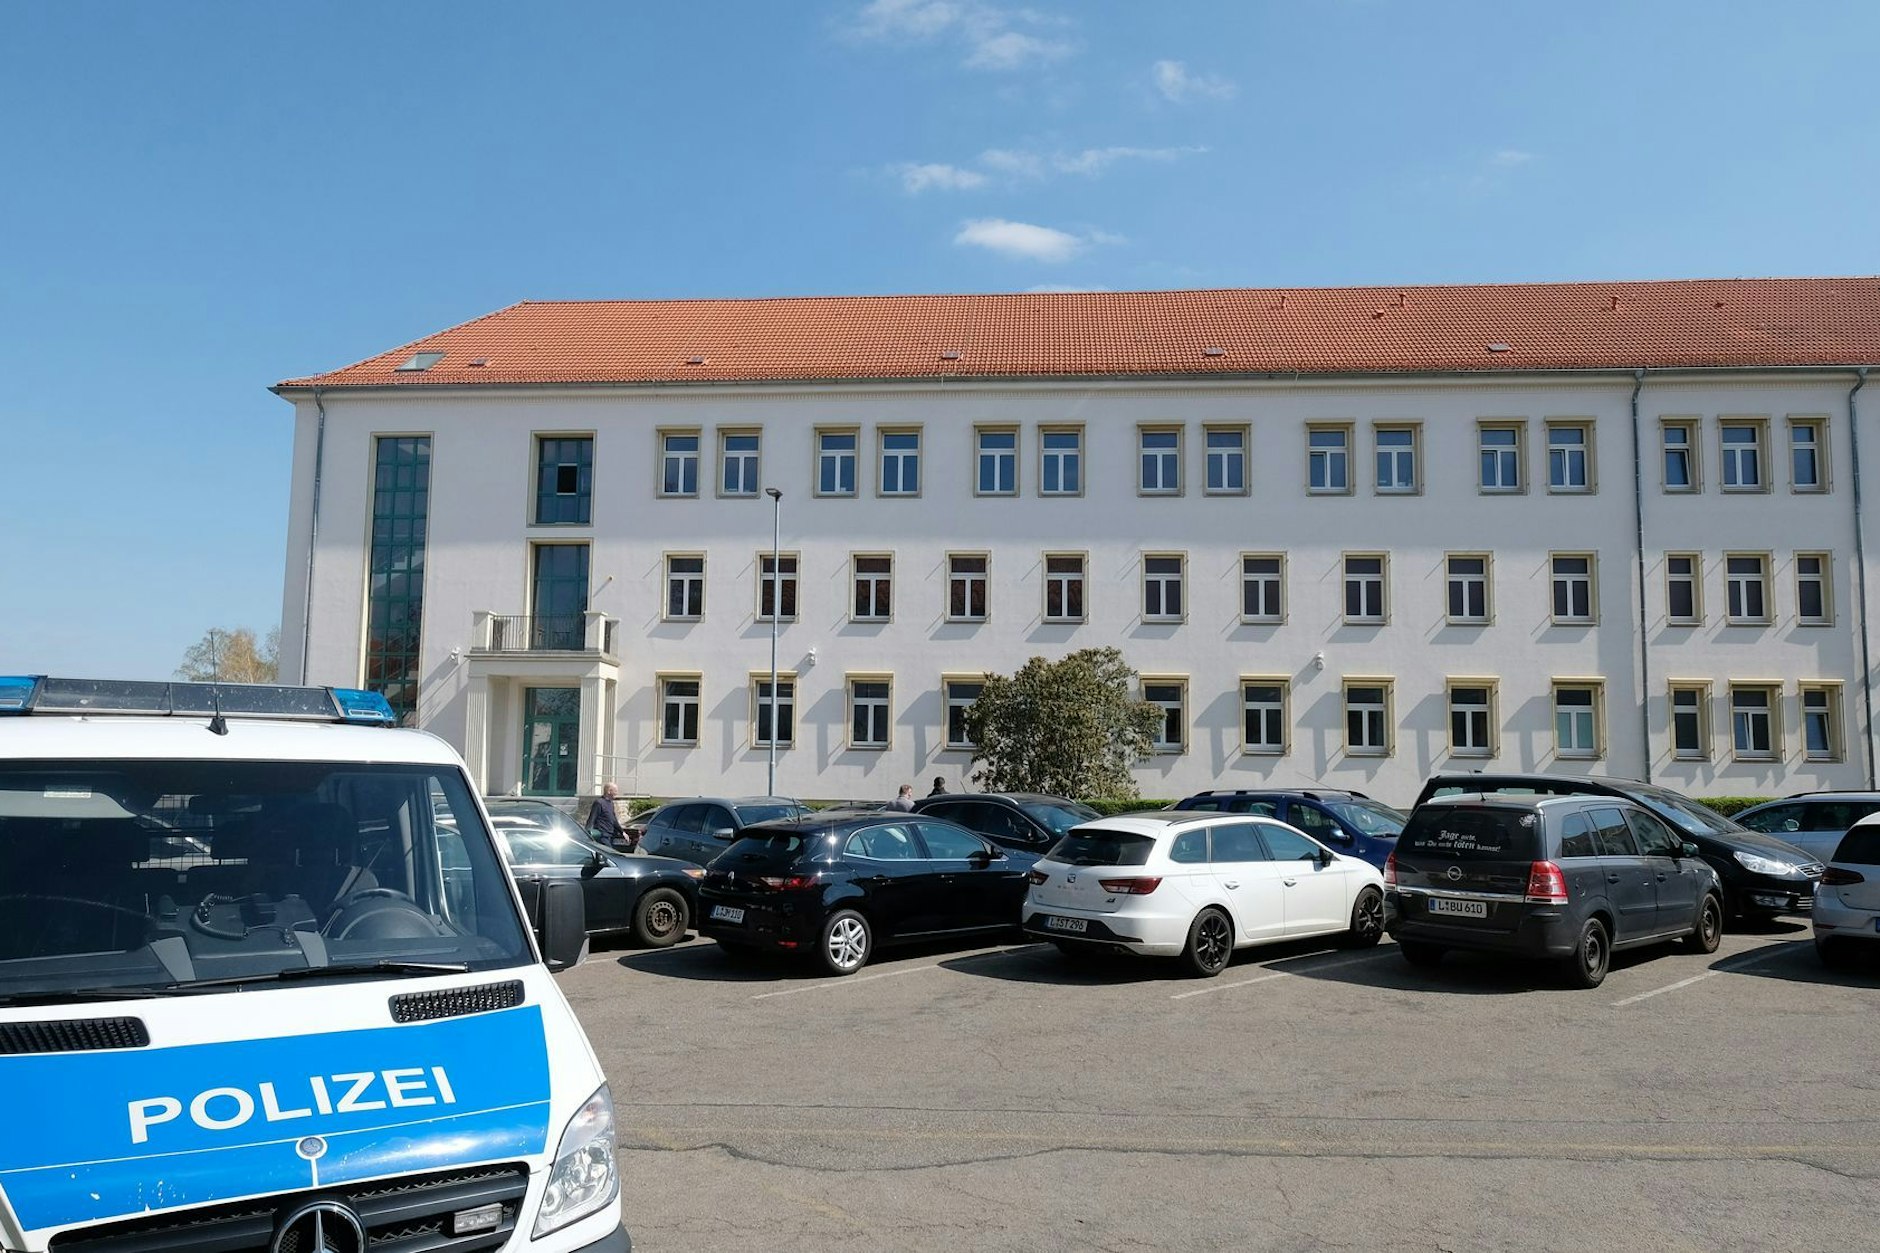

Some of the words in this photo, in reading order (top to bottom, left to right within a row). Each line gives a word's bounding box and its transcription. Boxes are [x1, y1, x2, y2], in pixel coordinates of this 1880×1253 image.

[1464, 902, 1483, 914] 610
[1069, 919, 1085, 931] 296
[127, 1065, 457, 1145] POLIZEI
